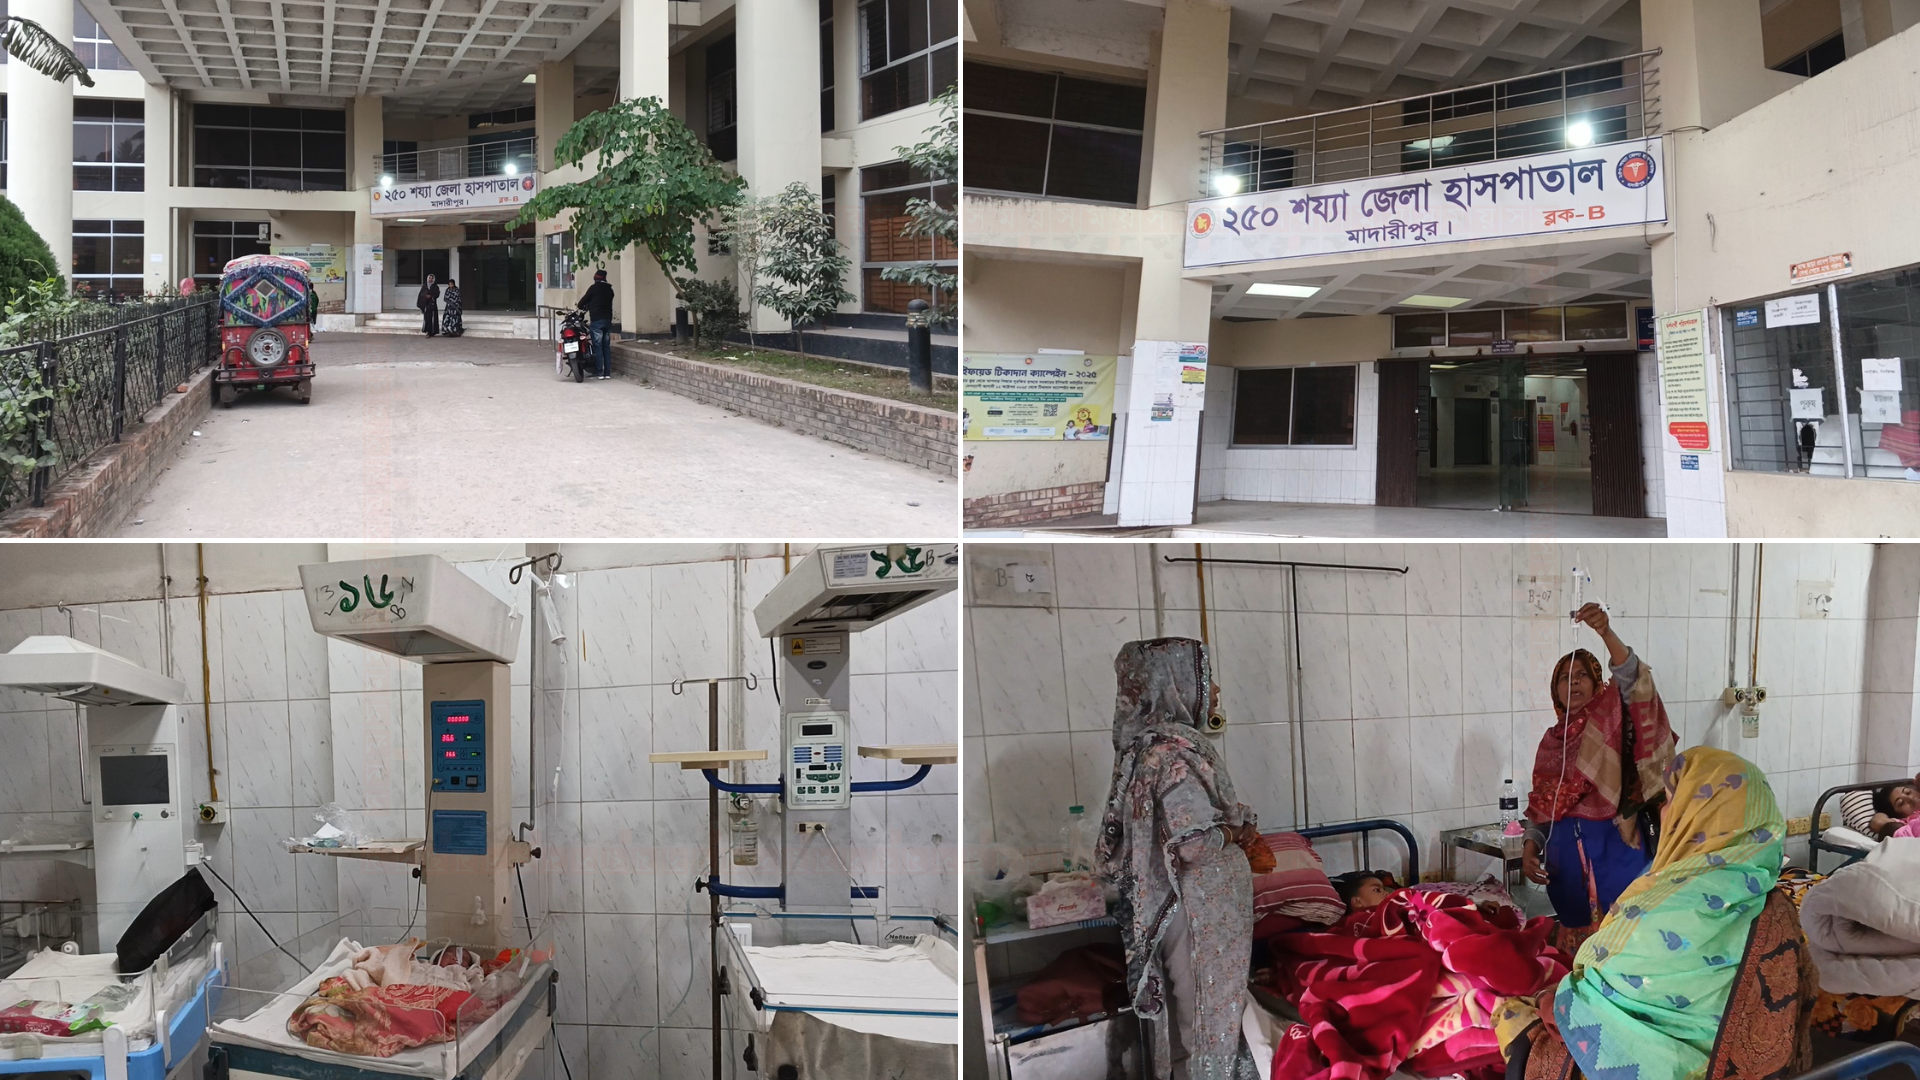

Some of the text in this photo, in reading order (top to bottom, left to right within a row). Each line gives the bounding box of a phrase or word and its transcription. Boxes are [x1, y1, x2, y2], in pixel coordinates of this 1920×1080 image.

[385, 177, 519, 202] ২৫০ শয্যা জেলা হাসপাতাল
[1223, 158, 1607, 236] ২৫০ শয্যা জেলা হাসপাতাল
[431, 198, 464, 208] মাদারীপুর
[1345, 219, 1438, 244] মাদারীপুর
[994, 366, 1027, 377] টিকাদান
[1030, 368, 1066, 378] ক্যাম্পেইন
[1075, 371, 1097, 379] ২০২৫
[1057, 902, 1077, 912] Fresh
